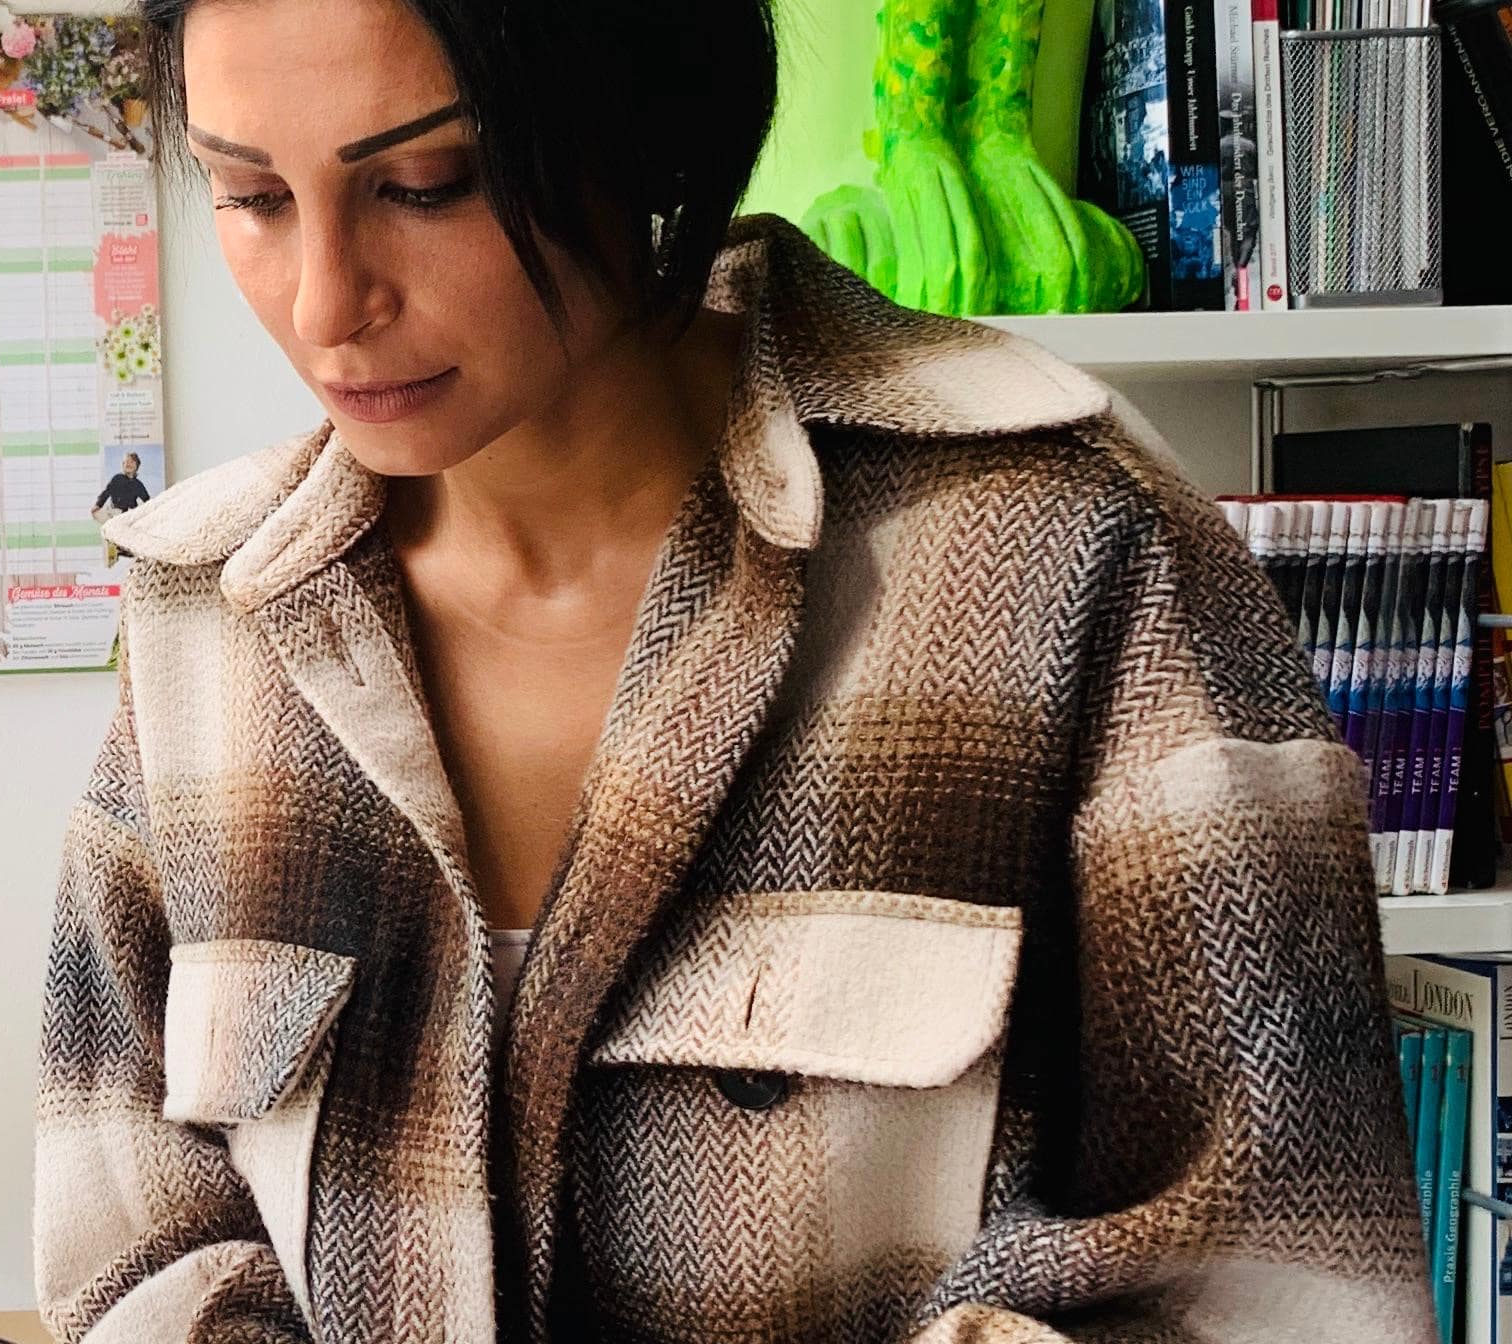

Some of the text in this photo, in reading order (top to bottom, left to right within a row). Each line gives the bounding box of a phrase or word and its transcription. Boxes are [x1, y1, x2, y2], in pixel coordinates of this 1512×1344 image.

[1180, 164, 1204, 177] WIR
[1377, 759, 1391, 797] TEAM
[1392, 757, 1406, 796] TEAM
[1411, 756, 1425, 796] TEAM
[1429, 756, 1442, 795] TEAM
[1448, 755, 1462, 795] TEAM
[1413, 969, 1474, 1020] LONDON
[1443, 1169, 1461, 1284] Praxis Geographie
